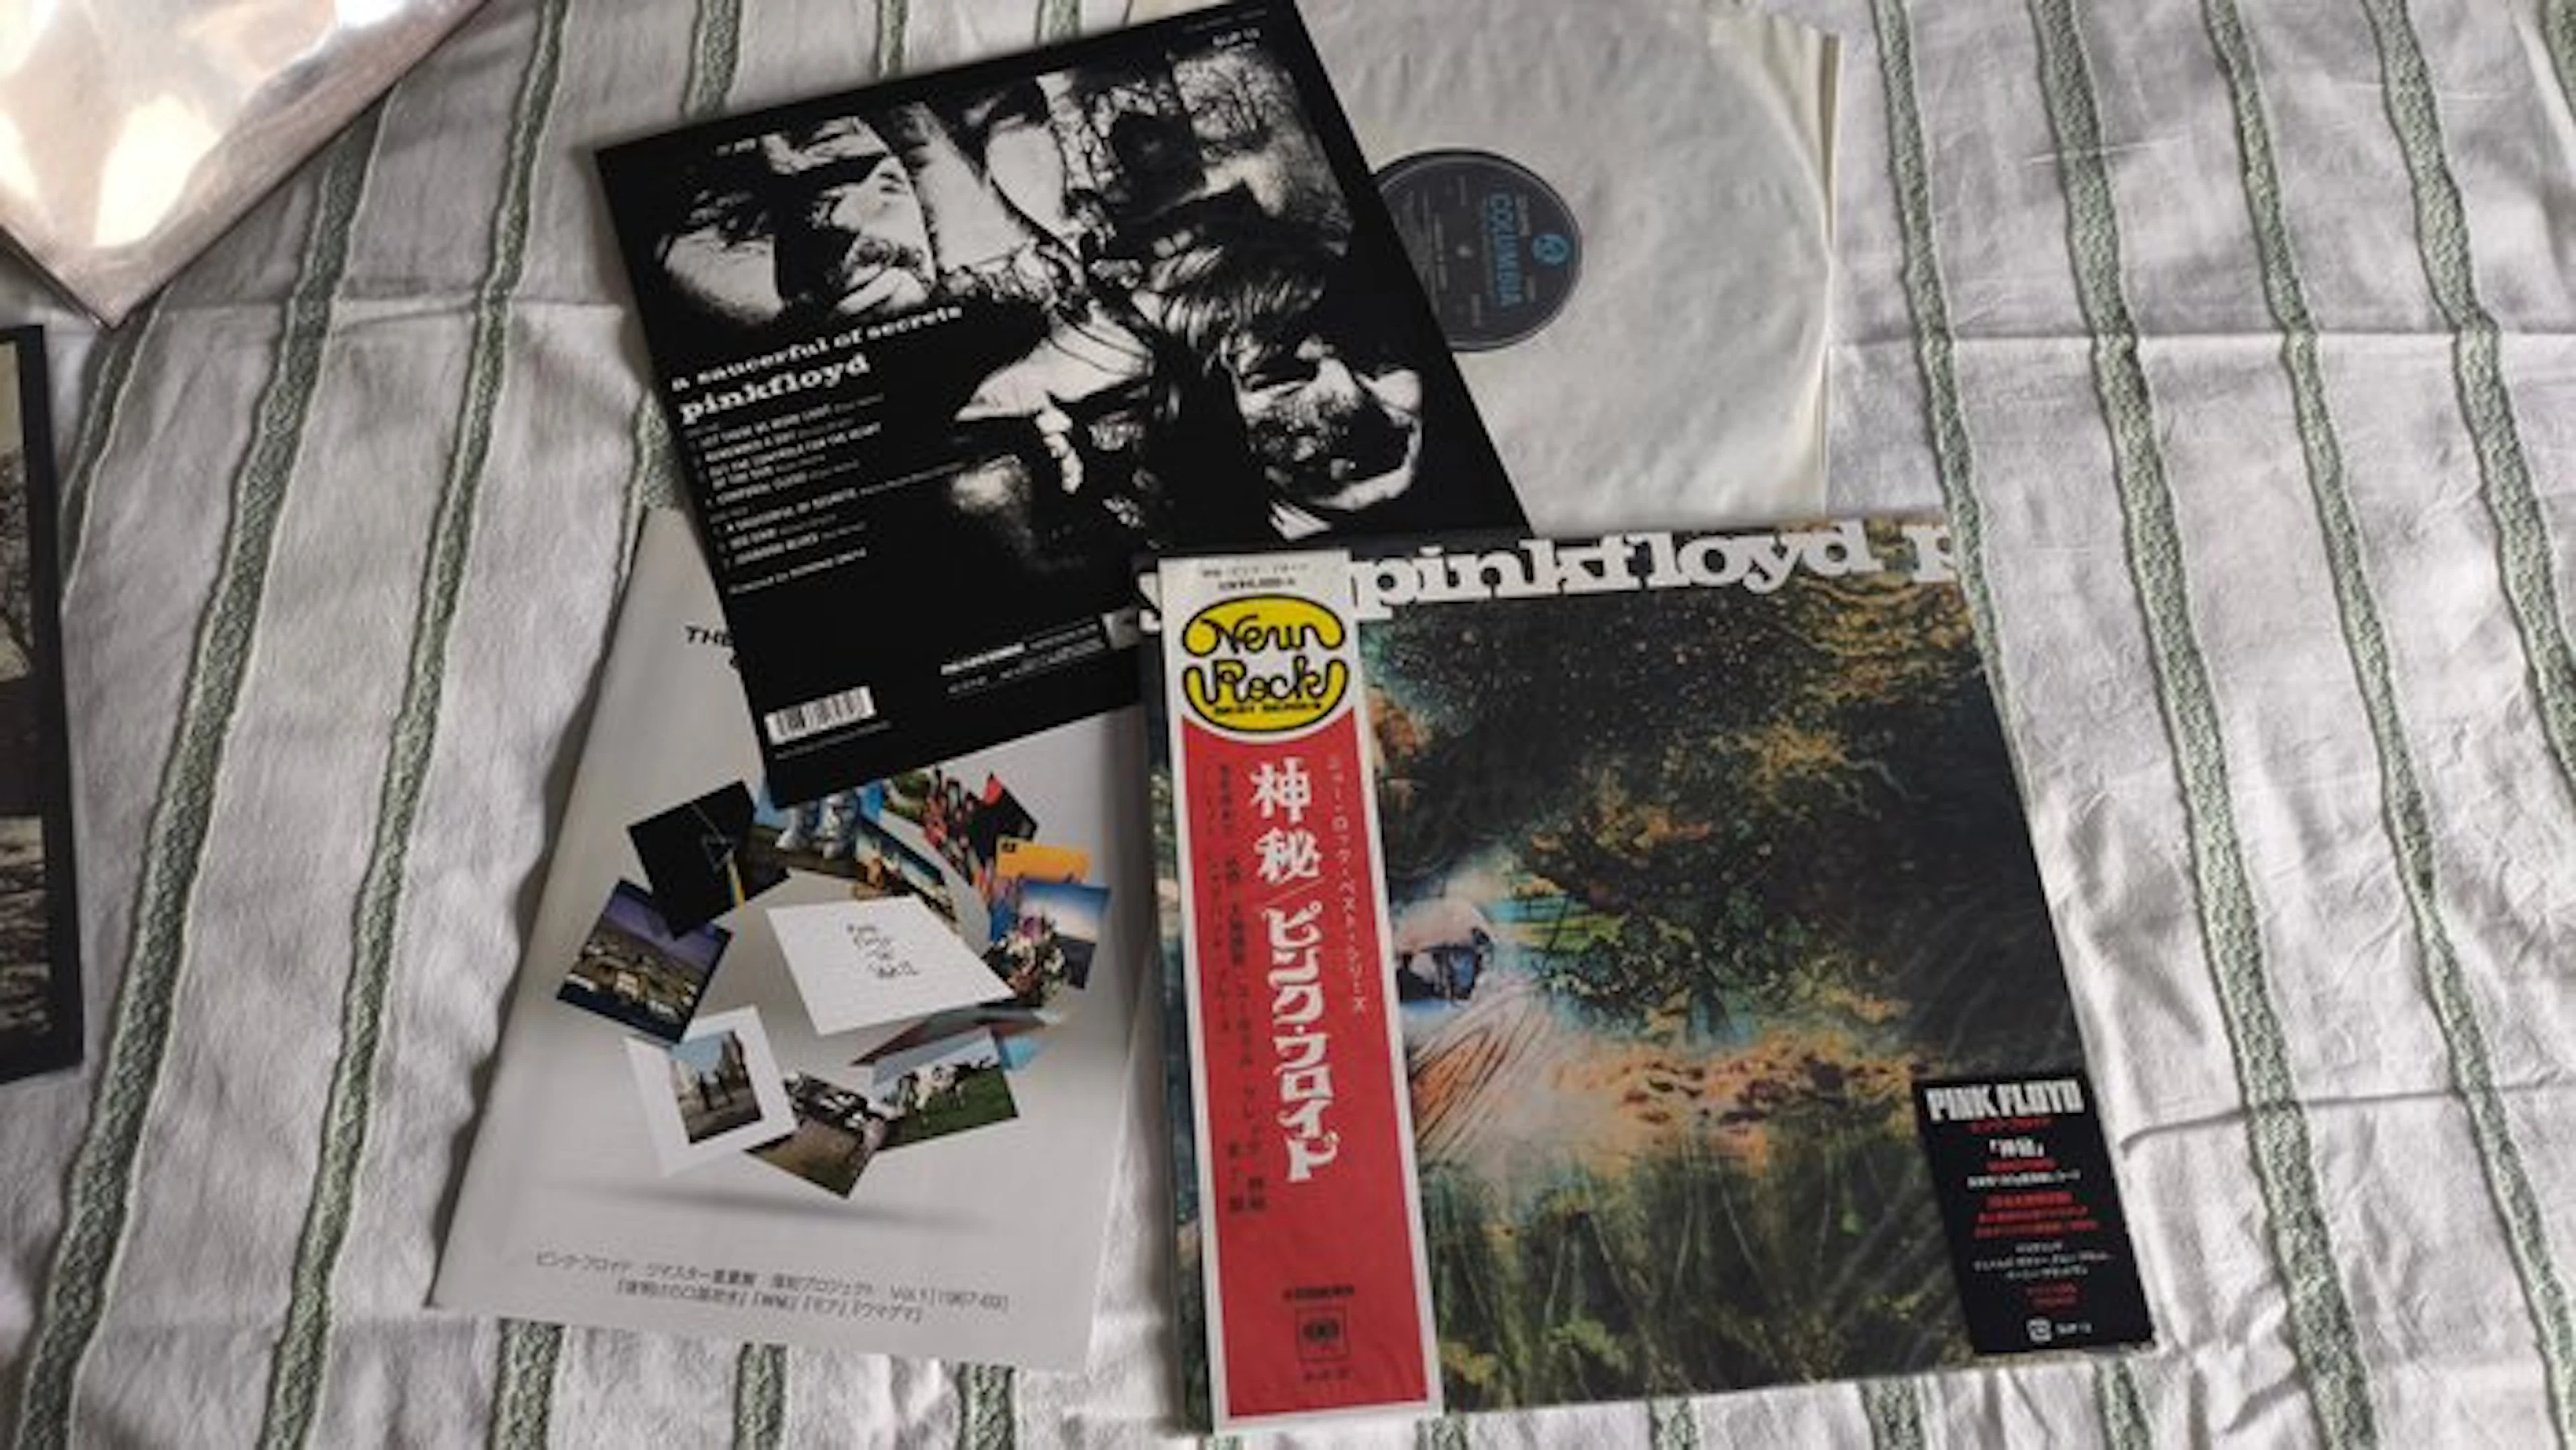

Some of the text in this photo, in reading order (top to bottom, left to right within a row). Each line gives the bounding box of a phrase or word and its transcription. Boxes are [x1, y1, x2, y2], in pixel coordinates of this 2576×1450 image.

[1487, 191, 1523, 307] COLUMBIA
[672, 307, 963, 392] a saucerful of secrets
[679, 352, 871, 426] pinkfloyd
[1352, 519, 1886, 620] pinkfloyd
[1199, 612, 1316, 654] New
[1205, 656, 1328, 703] Rock
[1250, 756, 1322, 884] 神秘
[1925, 1079, 2085, 1123] PINK FLOYD
